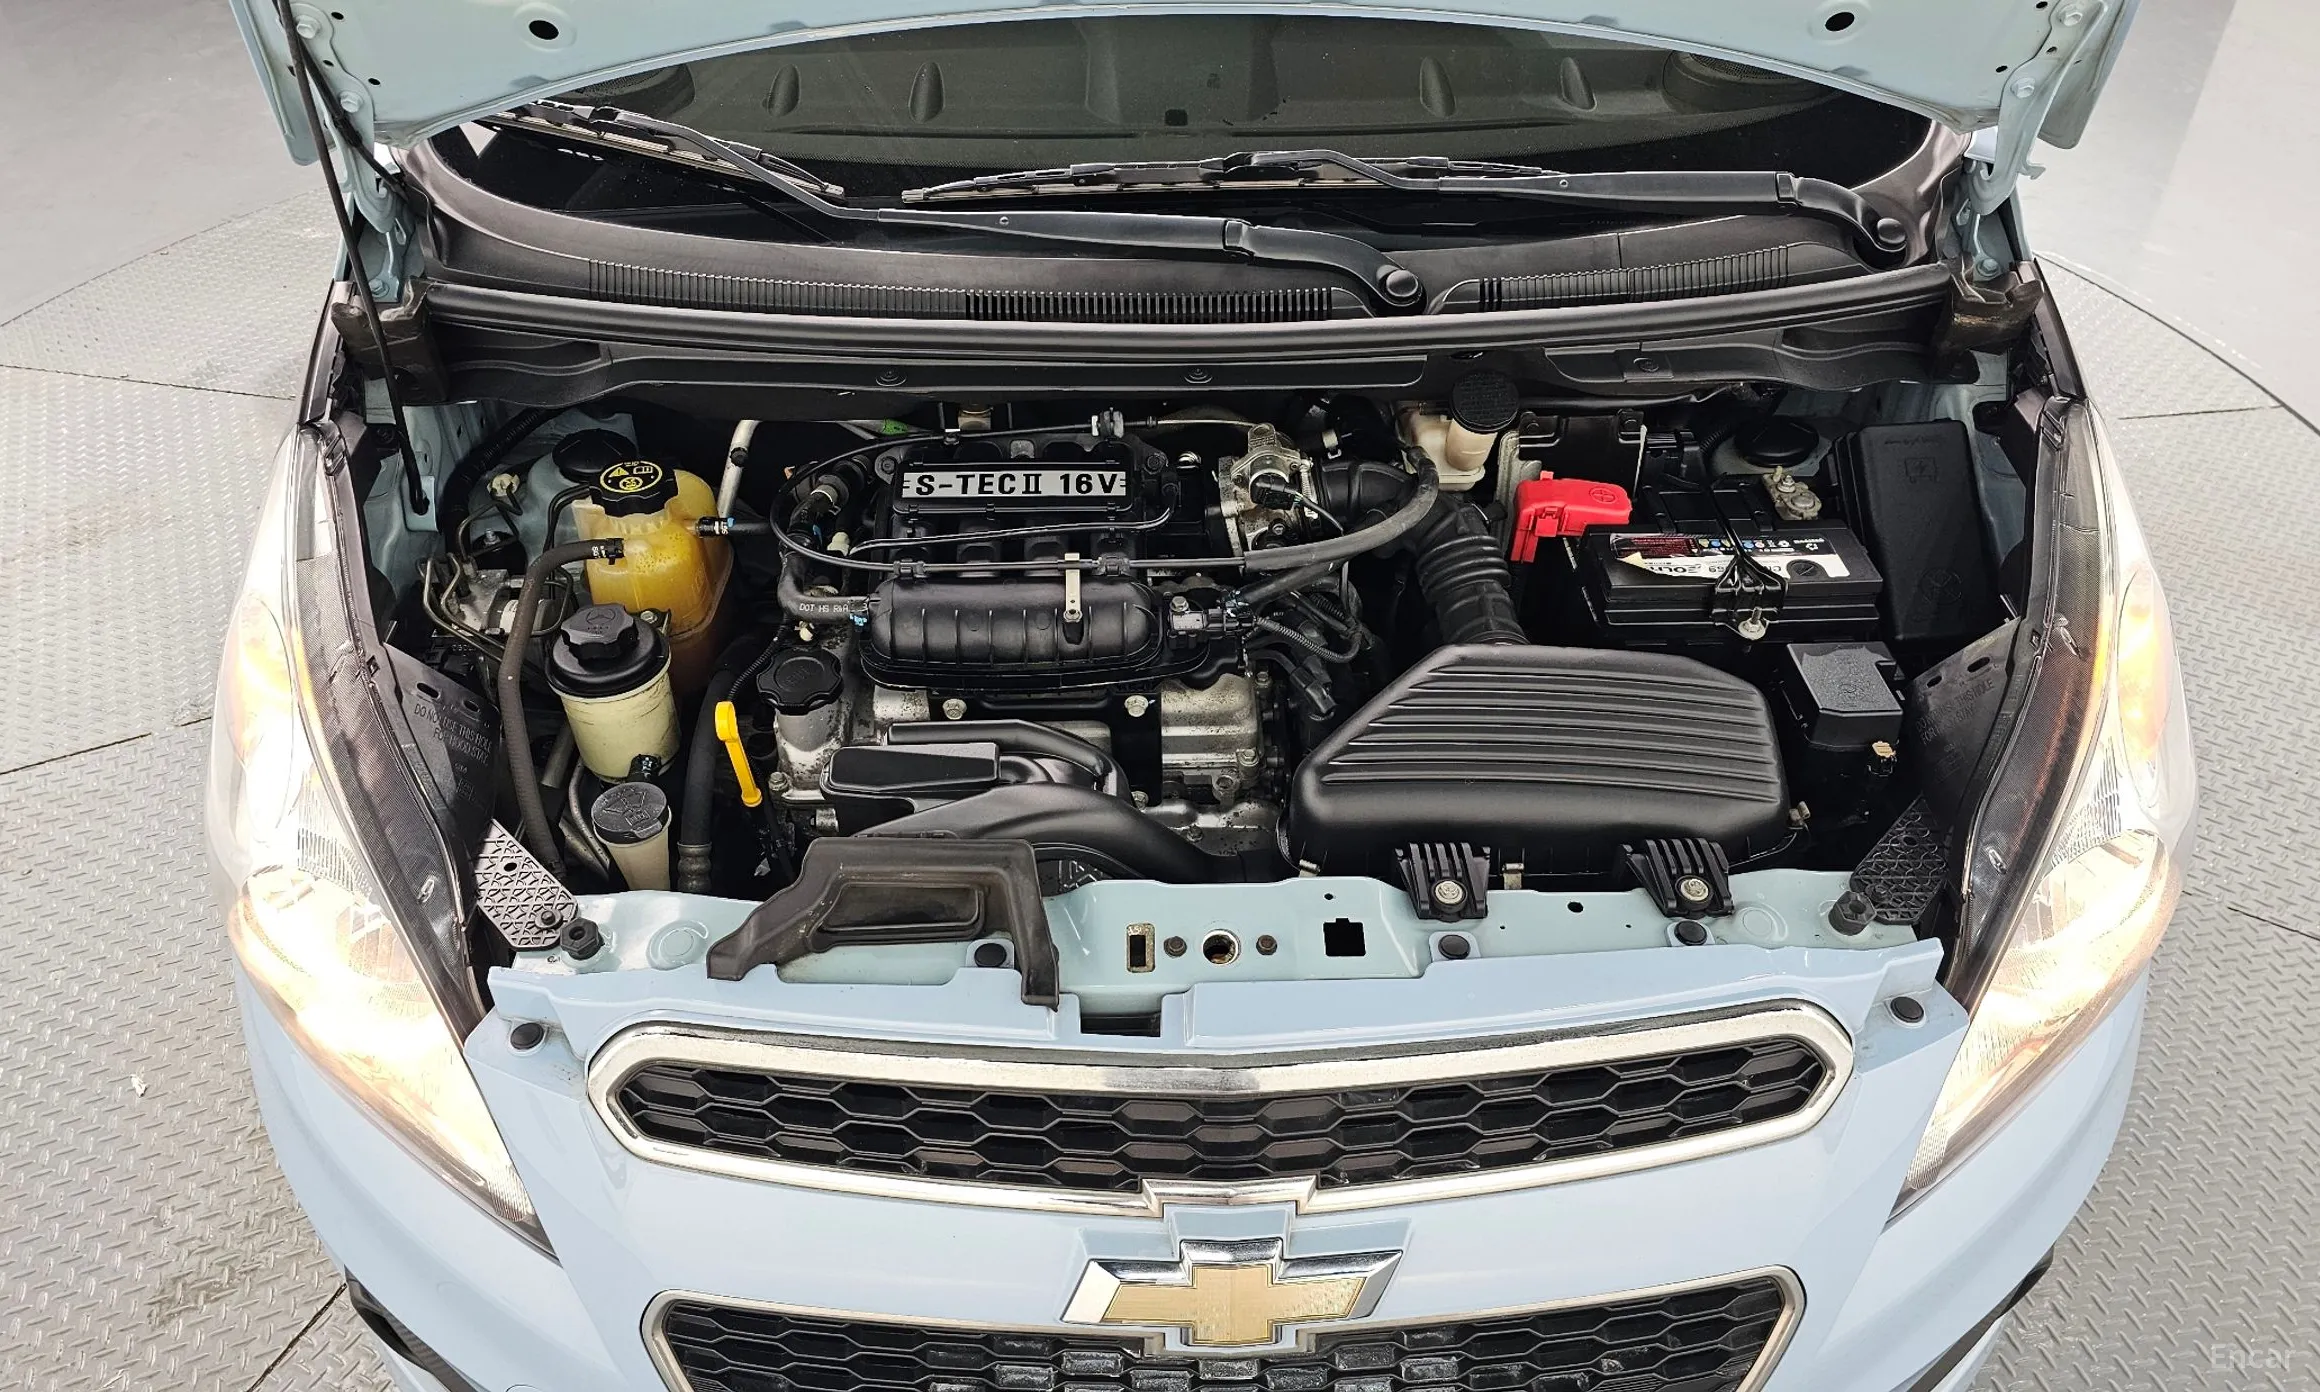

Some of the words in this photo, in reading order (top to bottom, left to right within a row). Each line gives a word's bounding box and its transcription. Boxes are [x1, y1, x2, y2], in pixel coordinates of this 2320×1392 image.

[1059, 473, 1118, 495] 16V
[799, 603, 815, 612] DOT
[818, 604, 830, 613] HS
[414, 703, 427, 717] DO
